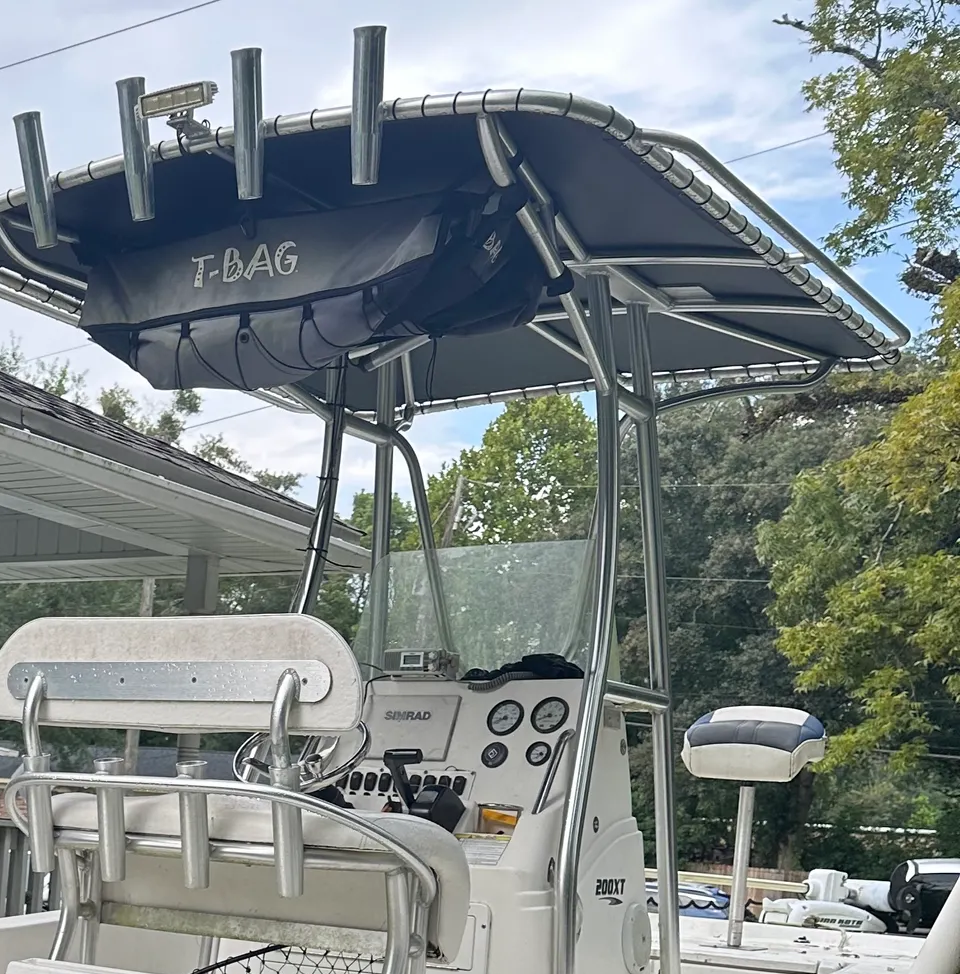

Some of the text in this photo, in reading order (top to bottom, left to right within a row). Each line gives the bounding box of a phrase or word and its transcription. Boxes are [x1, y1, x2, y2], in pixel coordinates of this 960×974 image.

[191, 241, 299, 288] T-BAG
[383, 710, 432, 721] SIMRAD
[595, 878, 626, 896] 200XT
